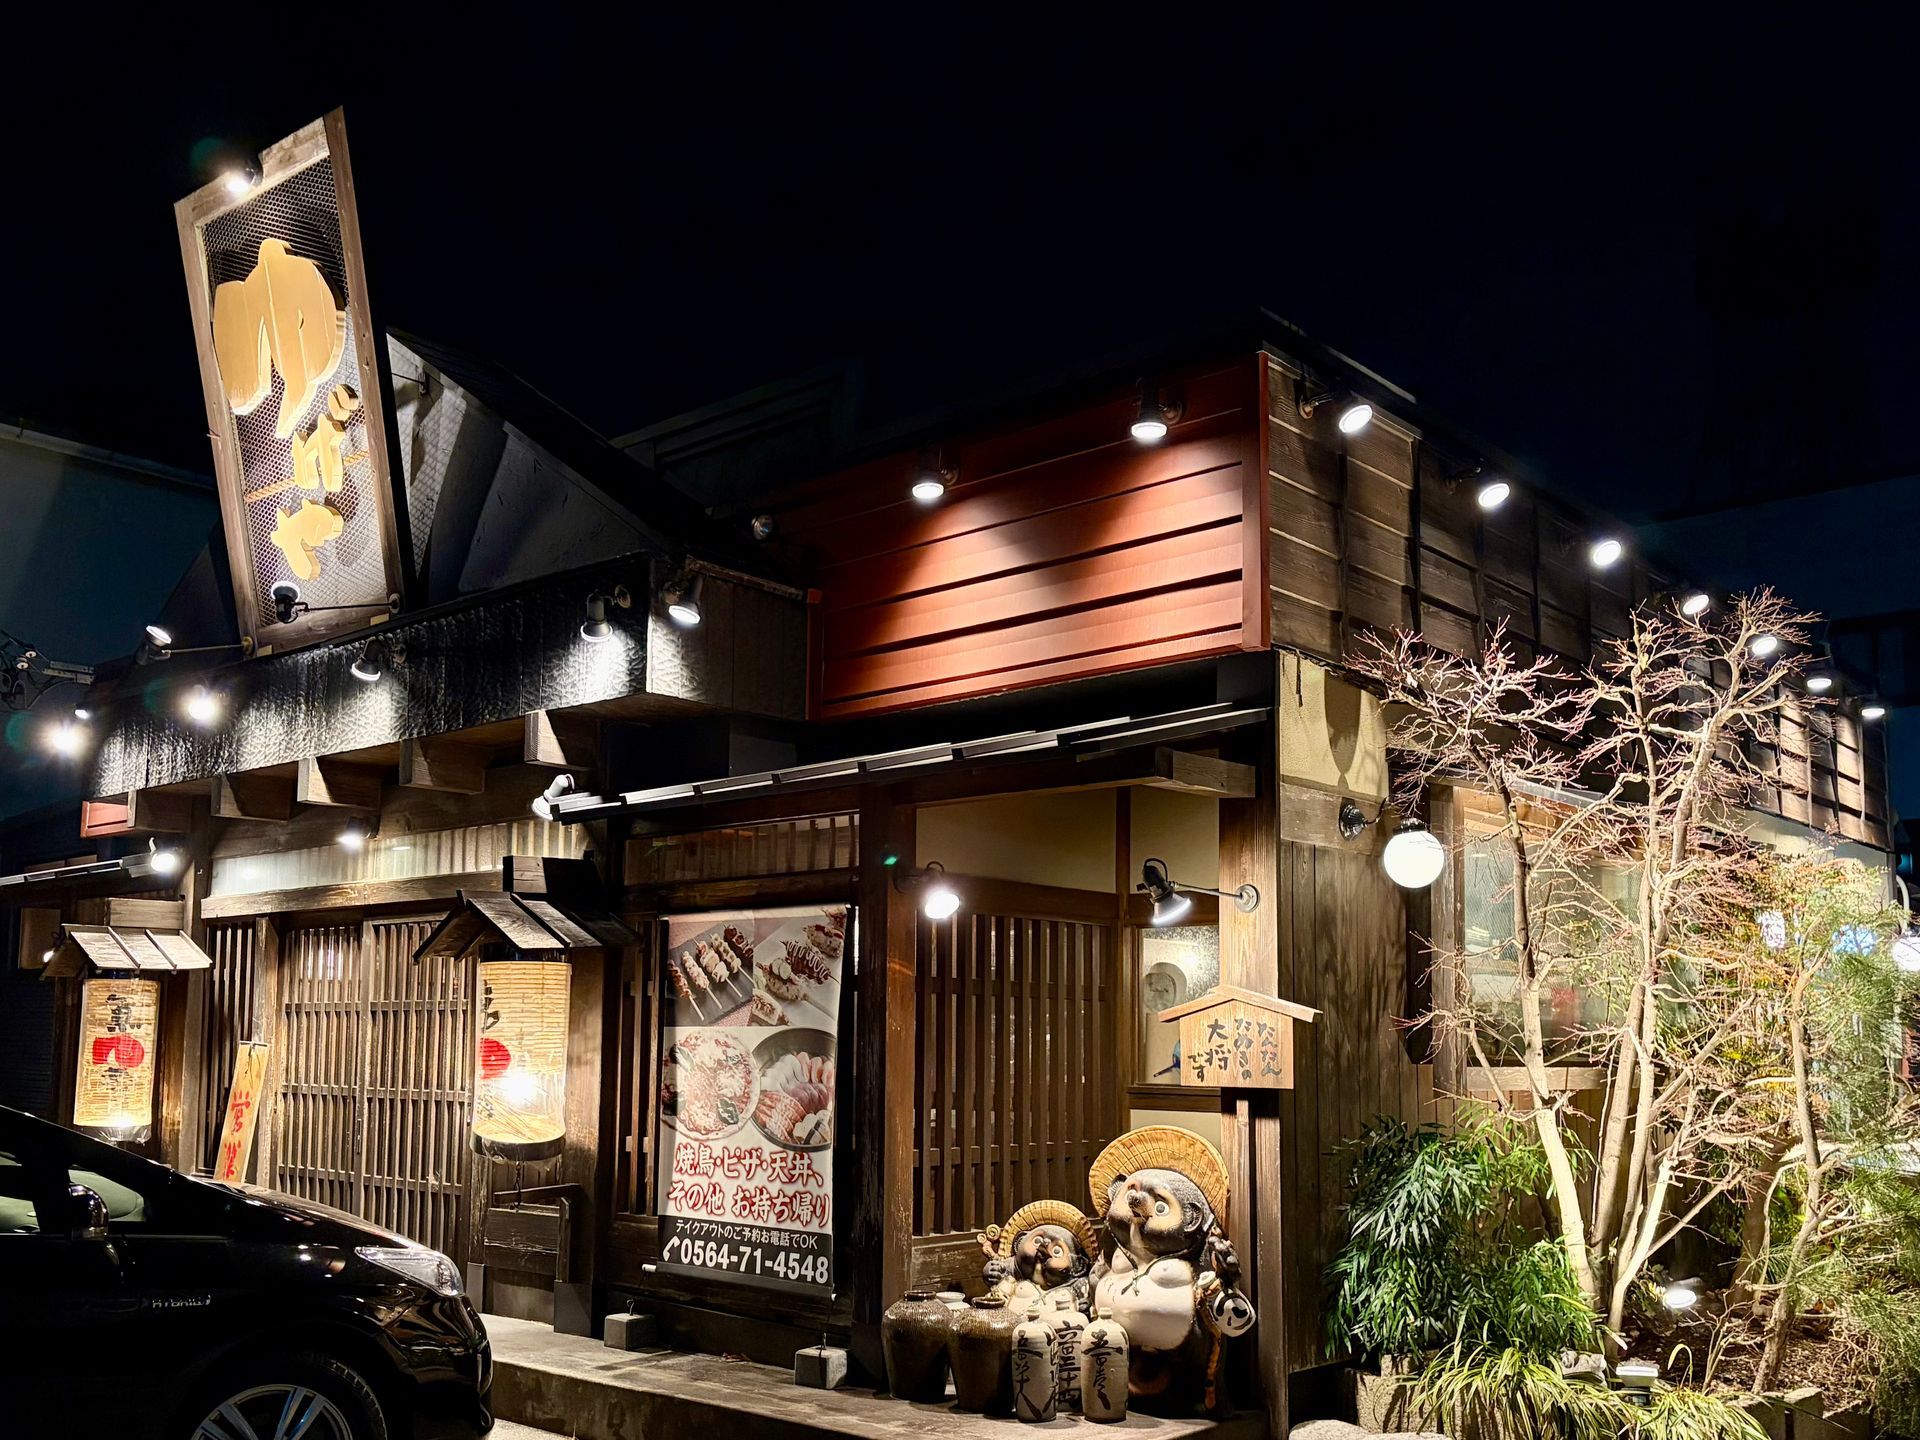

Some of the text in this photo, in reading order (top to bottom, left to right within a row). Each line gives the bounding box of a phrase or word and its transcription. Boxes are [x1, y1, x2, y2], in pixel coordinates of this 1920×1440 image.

[1187, 1052, 1206, 1083] です
[1204, 1018, 1232, 1071] 大将
[668, 1180, 831, 1228] その他 お持ち帰り
[675, 1219, 818, 1250] テイクアウトのご予約お電話でOK
[680, 1238, 829, 1284] 0564-71-4548
